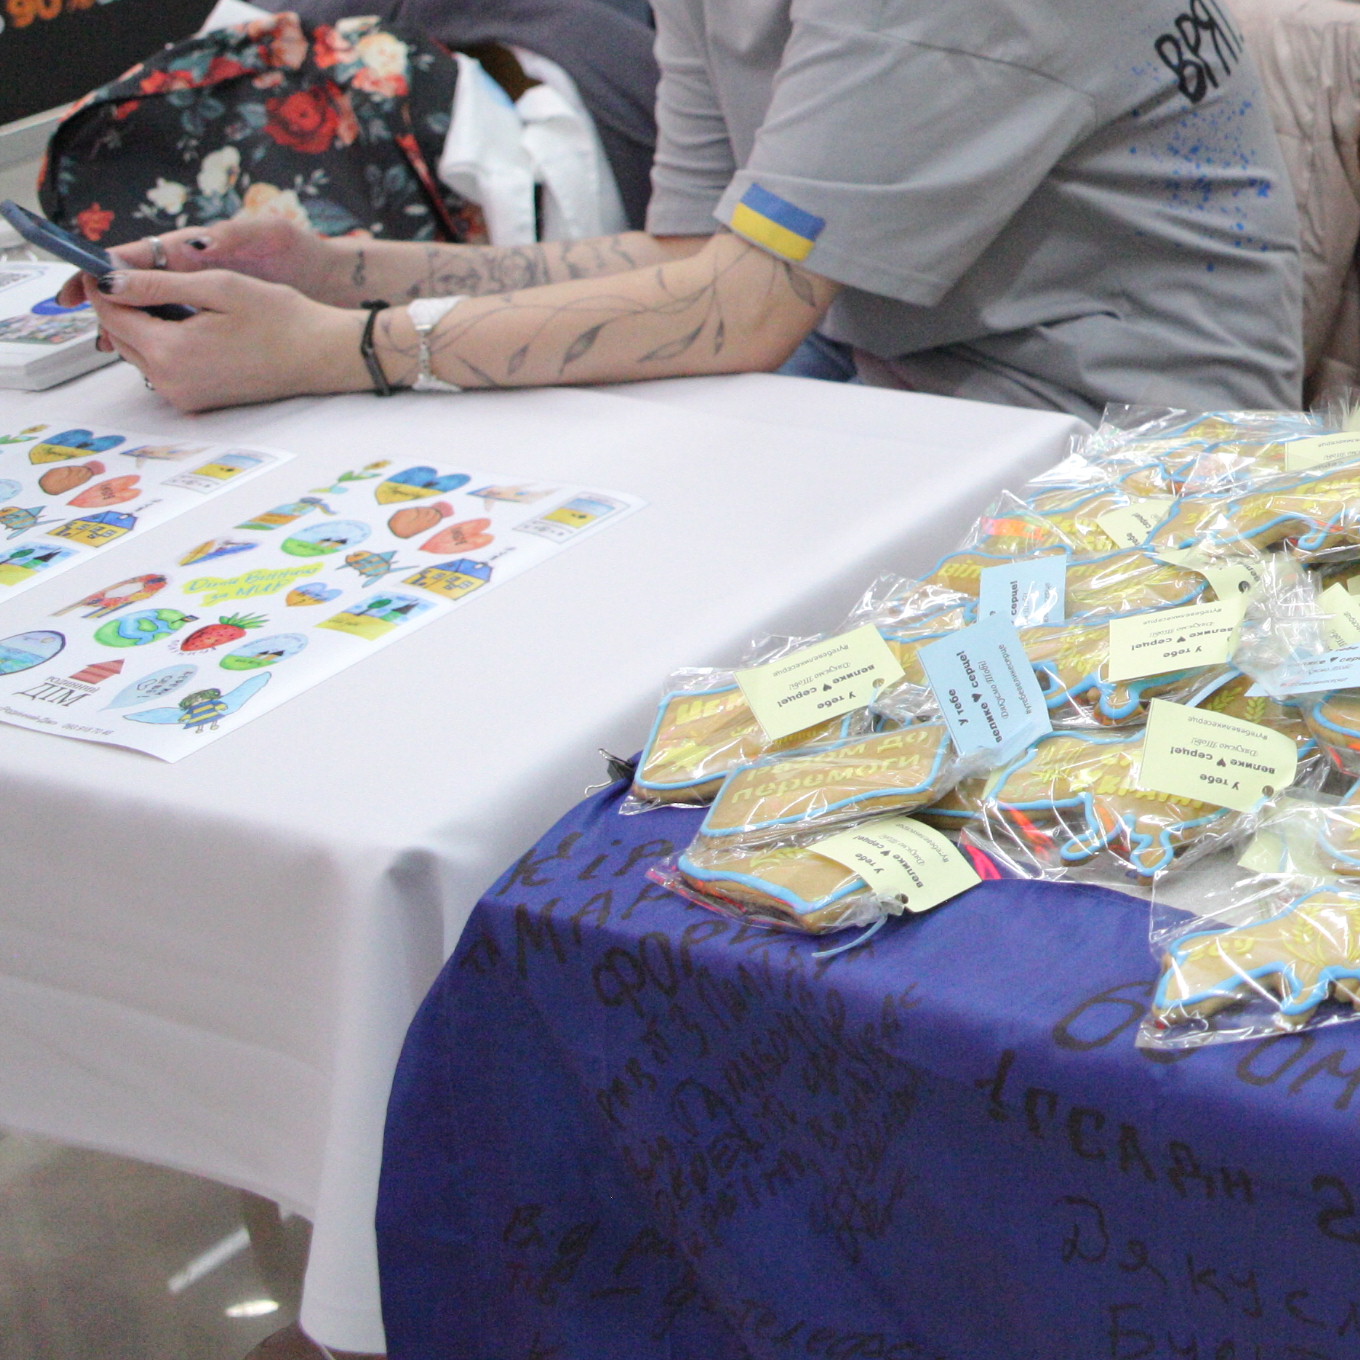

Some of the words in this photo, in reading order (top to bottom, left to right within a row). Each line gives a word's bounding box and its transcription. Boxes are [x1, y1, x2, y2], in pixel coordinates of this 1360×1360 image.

[1010, 580, 1018, 615] серце!
[1188, 627, 1234, 638] велике
[1131, 637, 1173, 651] серце!
[1163, 647, 1191, 658] тебе
[832, 664, 875, 685] велике
[956, 650, 979, 689] серце!
[13, 681, 91, 708] ДІМ
[777, 686, 818, 708] серце!
[816, 695, 845, 709] тебе
[948, 688, 965, 716] тебе
[981, 702, 1003, 743] велике
[1170, 746, 1214, 761] серце!
[1230, 758, 1276, 775] велике
[1199, 773, 1229, 786] тебе
[852, 835, 885, 850] серце!
[855, 852, 877, 868] тебе
[892, 853, 924, 889] велике
